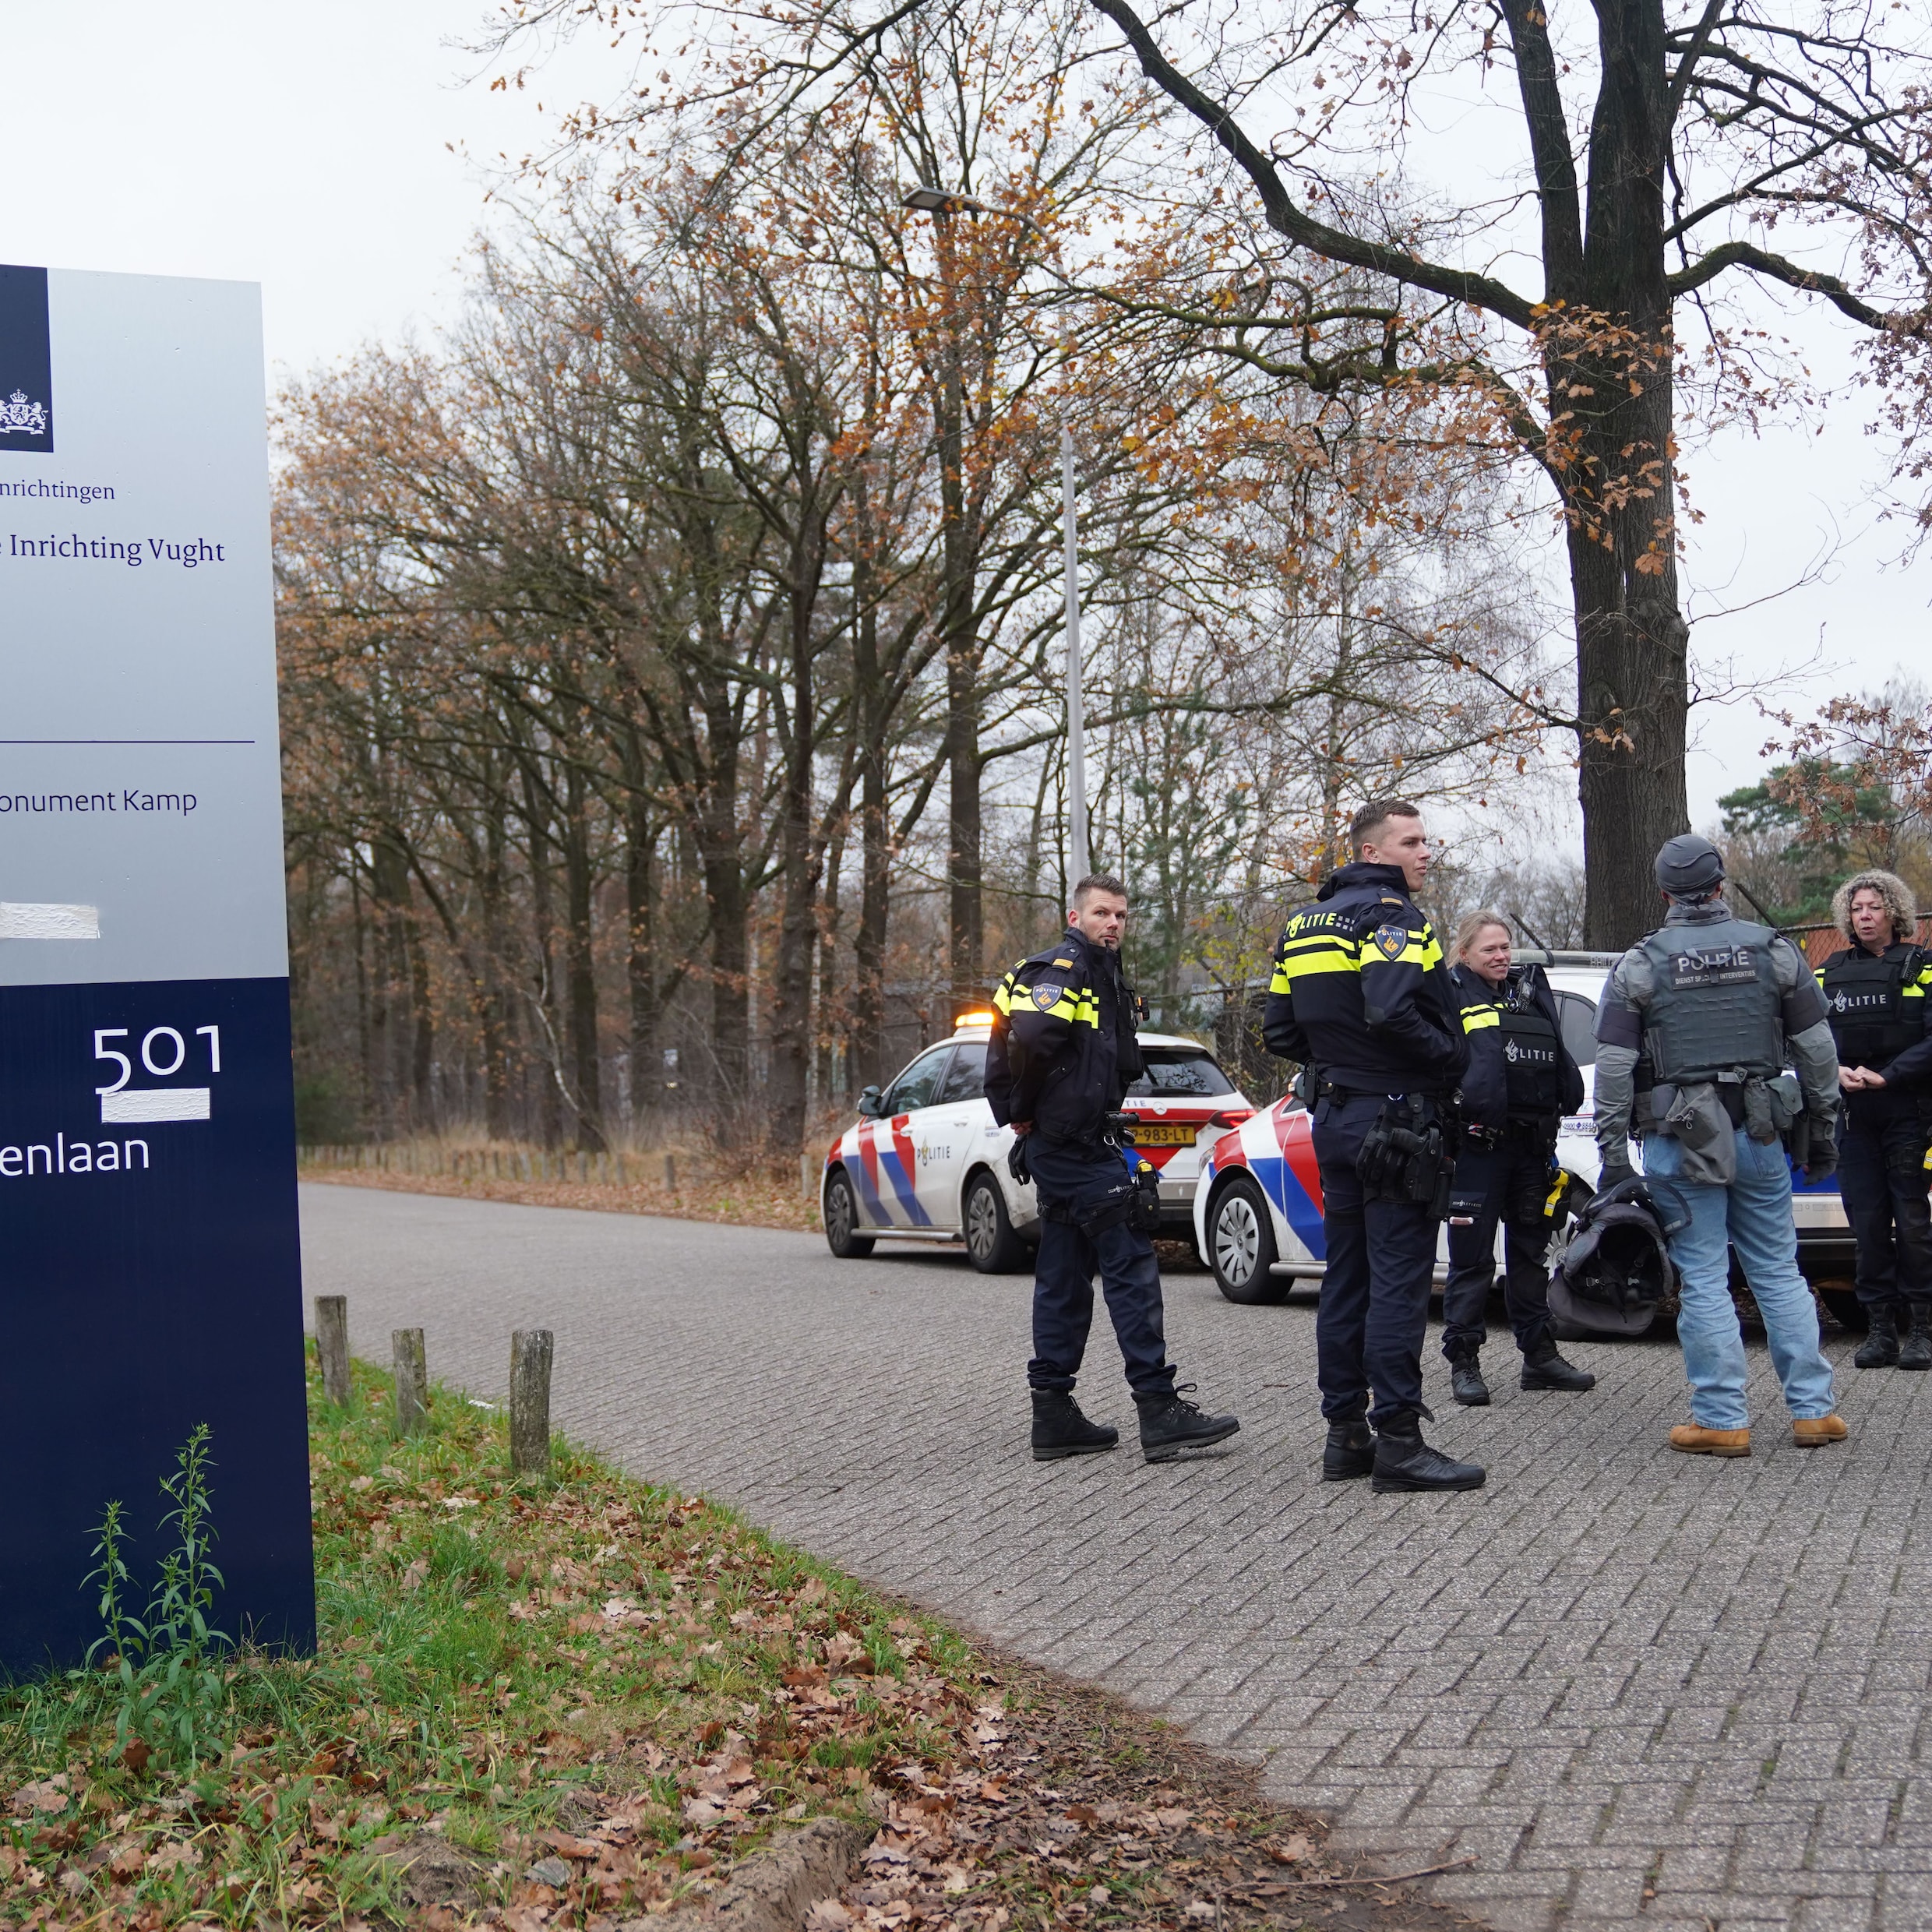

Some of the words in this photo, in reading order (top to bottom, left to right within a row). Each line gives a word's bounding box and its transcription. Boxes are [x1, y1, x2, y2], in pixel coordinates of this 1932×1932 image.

[10, 534, 142, 566] Inrichting
[148, 538, 225, 568] Vught
[124, 790, 197, 816] Kamp
[1378, 928, 1402, 936] POLITIE
[1675, 976, 1694, 985] DIENST
[1719, 970, 1756, 979] INTERVENTIES
[94, 1024, 220, 1095] 501
[1502, 1040, 1554, 1062] OLITIE
[0, 1132, 150, 1176] enlaan
[917, 1141, 950, 1165] POLITIE
